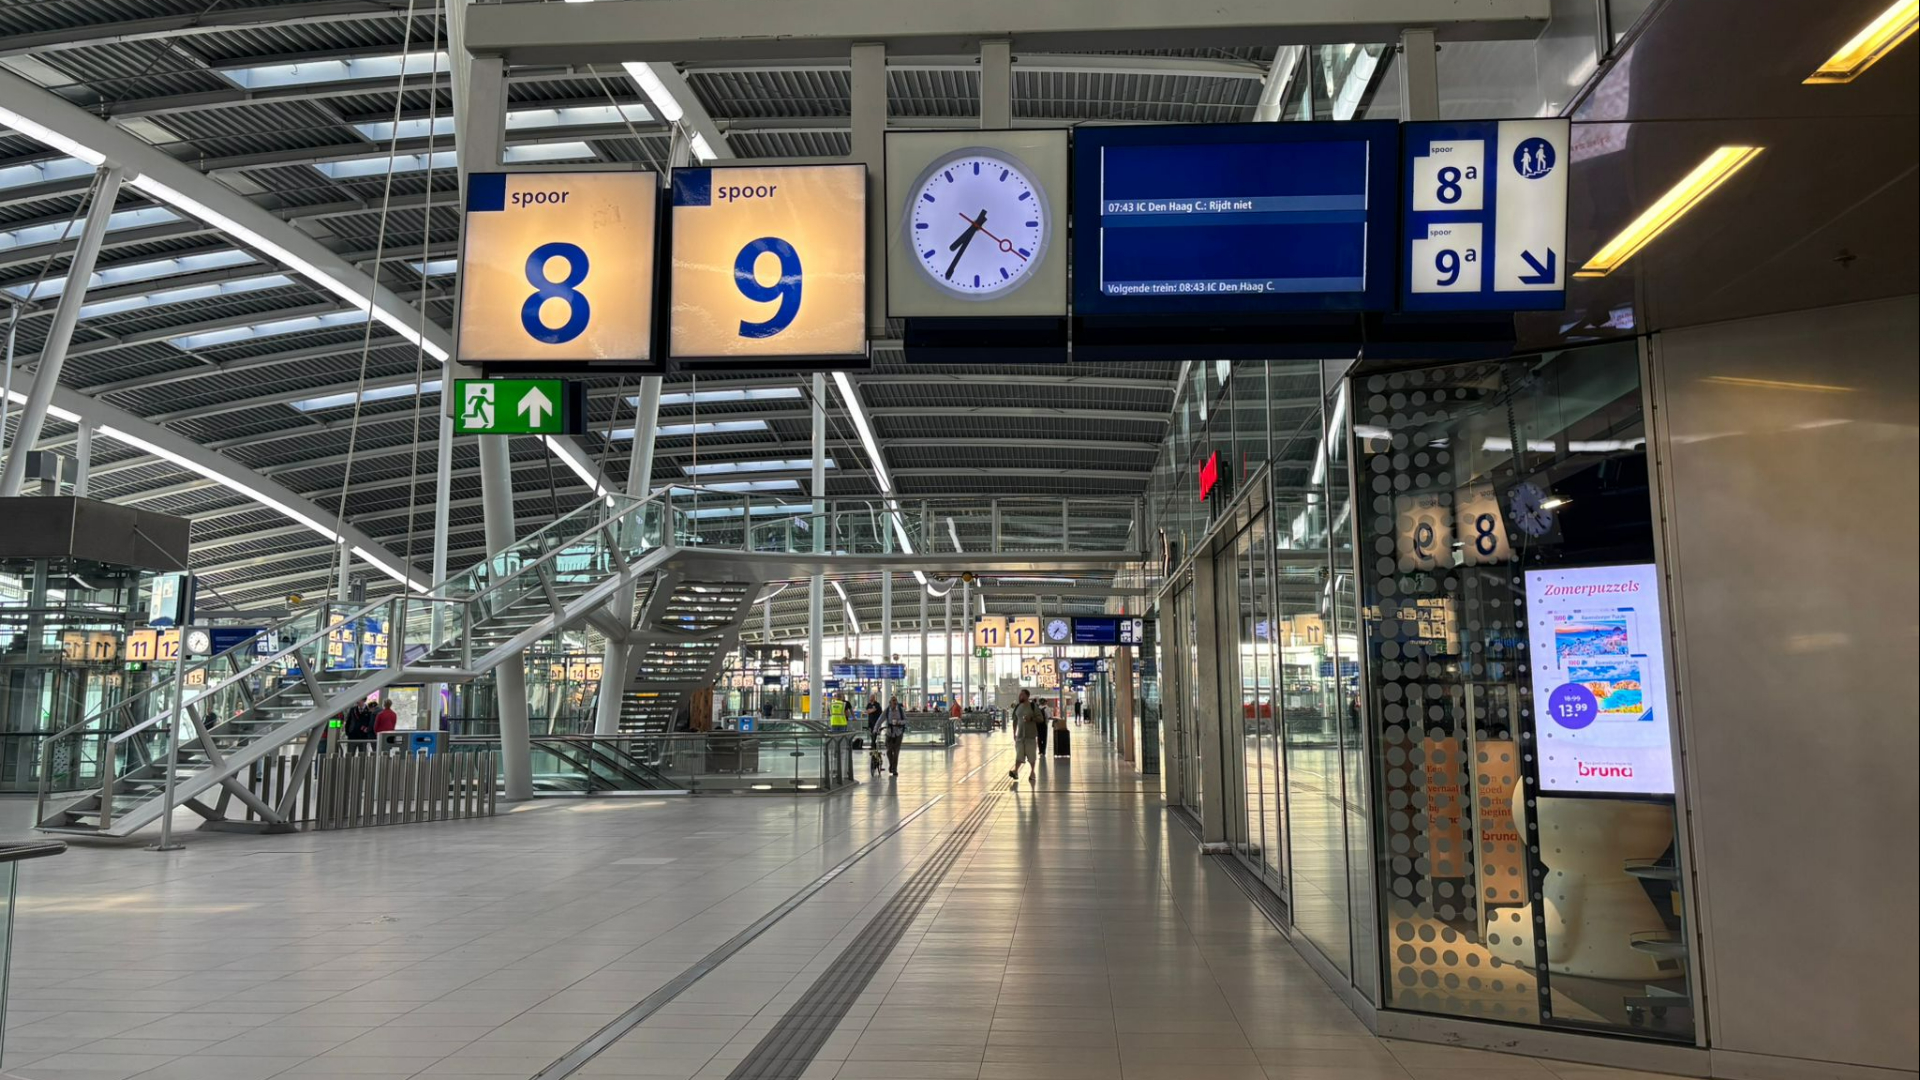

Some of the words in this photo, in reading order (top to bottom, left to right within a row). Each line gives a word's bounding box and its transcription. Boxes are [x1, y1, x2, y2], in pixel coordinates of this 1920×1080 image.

[1431, 146, 1454, 154] spoor
[511, 190, 570, 208] spoor
[717, 185, 777, 203] spoor
[1108, 202, 1134, 213] 07:43
[1136, 202, 1147, 212] IC
[1148, 202, 1167, 212] Den
[1169, 202, 1193, 213] Haag
[1195, 201, 1207, 211] C.:
[1209, 201, 1231, 212] Rijdt
[1234, 201, 1253, 210] niet
[1430, 229, 1453, 238] spoor
[521, 242, 591, 344] 8
[733, 237, 803, 339] 9
[1107, 284, 1151, 295] Volgende
[1153, 284, 1177, 293] trein:
[1179, 283, 1205, 293] 08:43
[1207, 283, 1217, 292] IC
[1219, 282, 1237, 291] Den
[1240, 282, 1264, 293] Haag
[1266, 281, 1276, 291] C.
[1544, 580, 1640, 597] Zomerpuzzels
[980, 627, 997, 644] 11
[1014, 627, 1036, 645] 12
[131, 641, 149, 658] 11
[161, 641, 179, 658] 12
[572, 669, 584, 679] 14
[589, 669, 601, 679] 15
[1024, 665, 1037, 675] 14
[1042, 664, 1053, 674] 15
[1558, 703, 1588, 718] 13.99
[1578, 761, 1633, 778] bruna
[1479, 786, 1502, 796] goed
[1482, 830, 1518, 841] bruna
